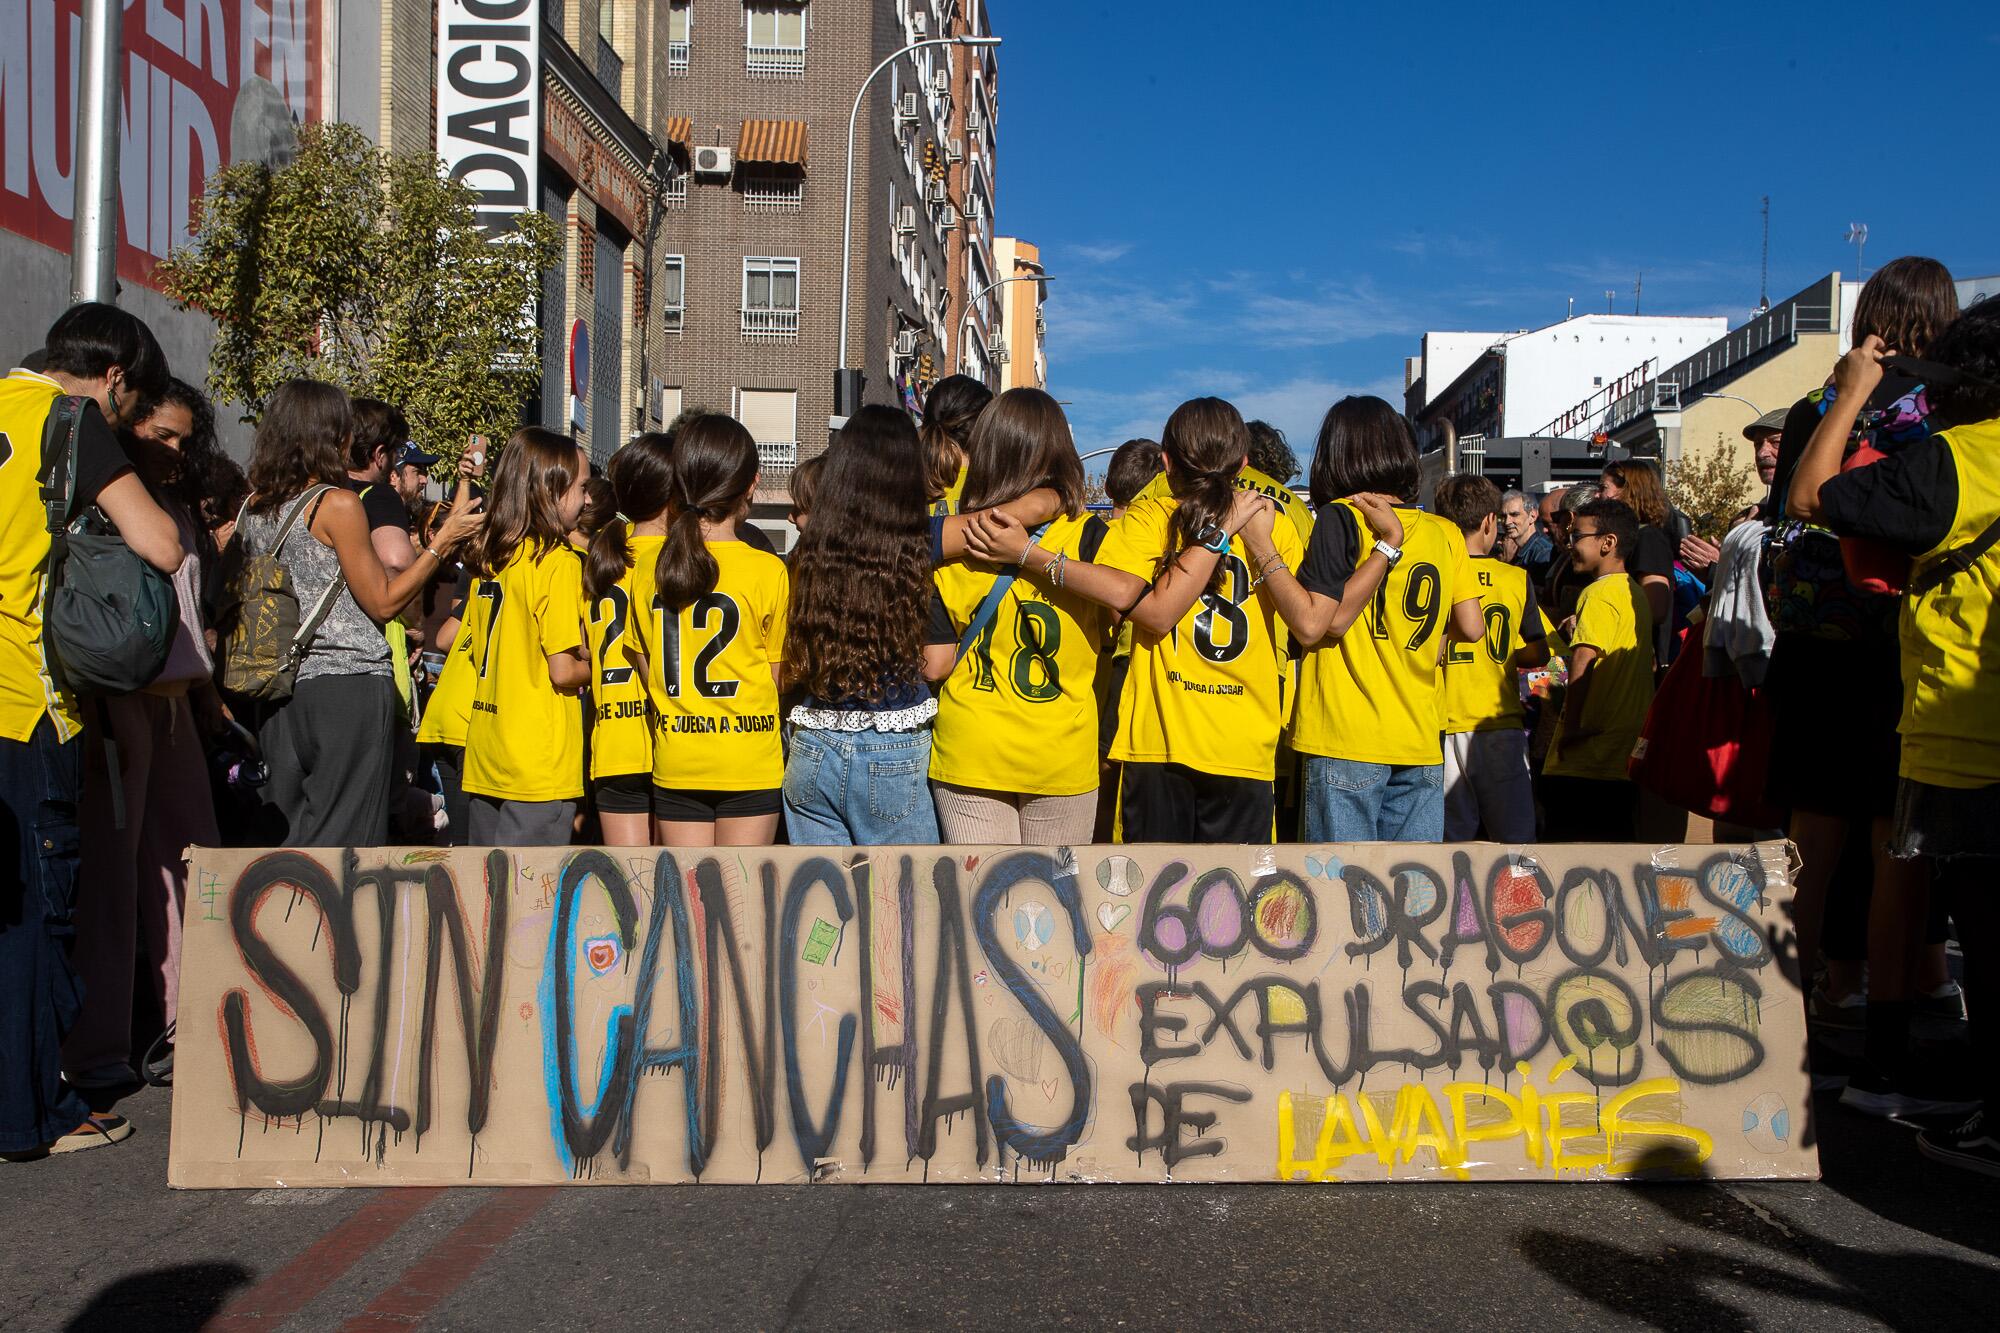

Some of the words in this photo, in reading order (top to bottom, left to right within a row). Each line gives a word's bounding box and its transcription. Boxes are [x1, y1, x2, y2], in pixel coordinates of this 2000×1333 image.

[1170, 553, 1249, 664] 8
[1478, 571, 1493, 587] EL
[652, 591, 740, 698] 12
[968, 596, 1063, 704] 18
[1208, 684, 1215, 694] A
[1216, 684, 1243, 696] JUGAR
[671, 715, 716, 734] JUEGA
[720, 716, 730, 734] A
[734, 714, 775, 733] JUGAR
[1137, 860, 1320, 966] 600
[1339, 850, 1774, 972] DRAGONES
[219, 847, 510, 1145] SIN
[543, 848, 1094, 1175] CANCHAS
[1137, 965, 1766, 1088] EXPULSAD@S
[1126, 1081, 1253, 1168] DE
